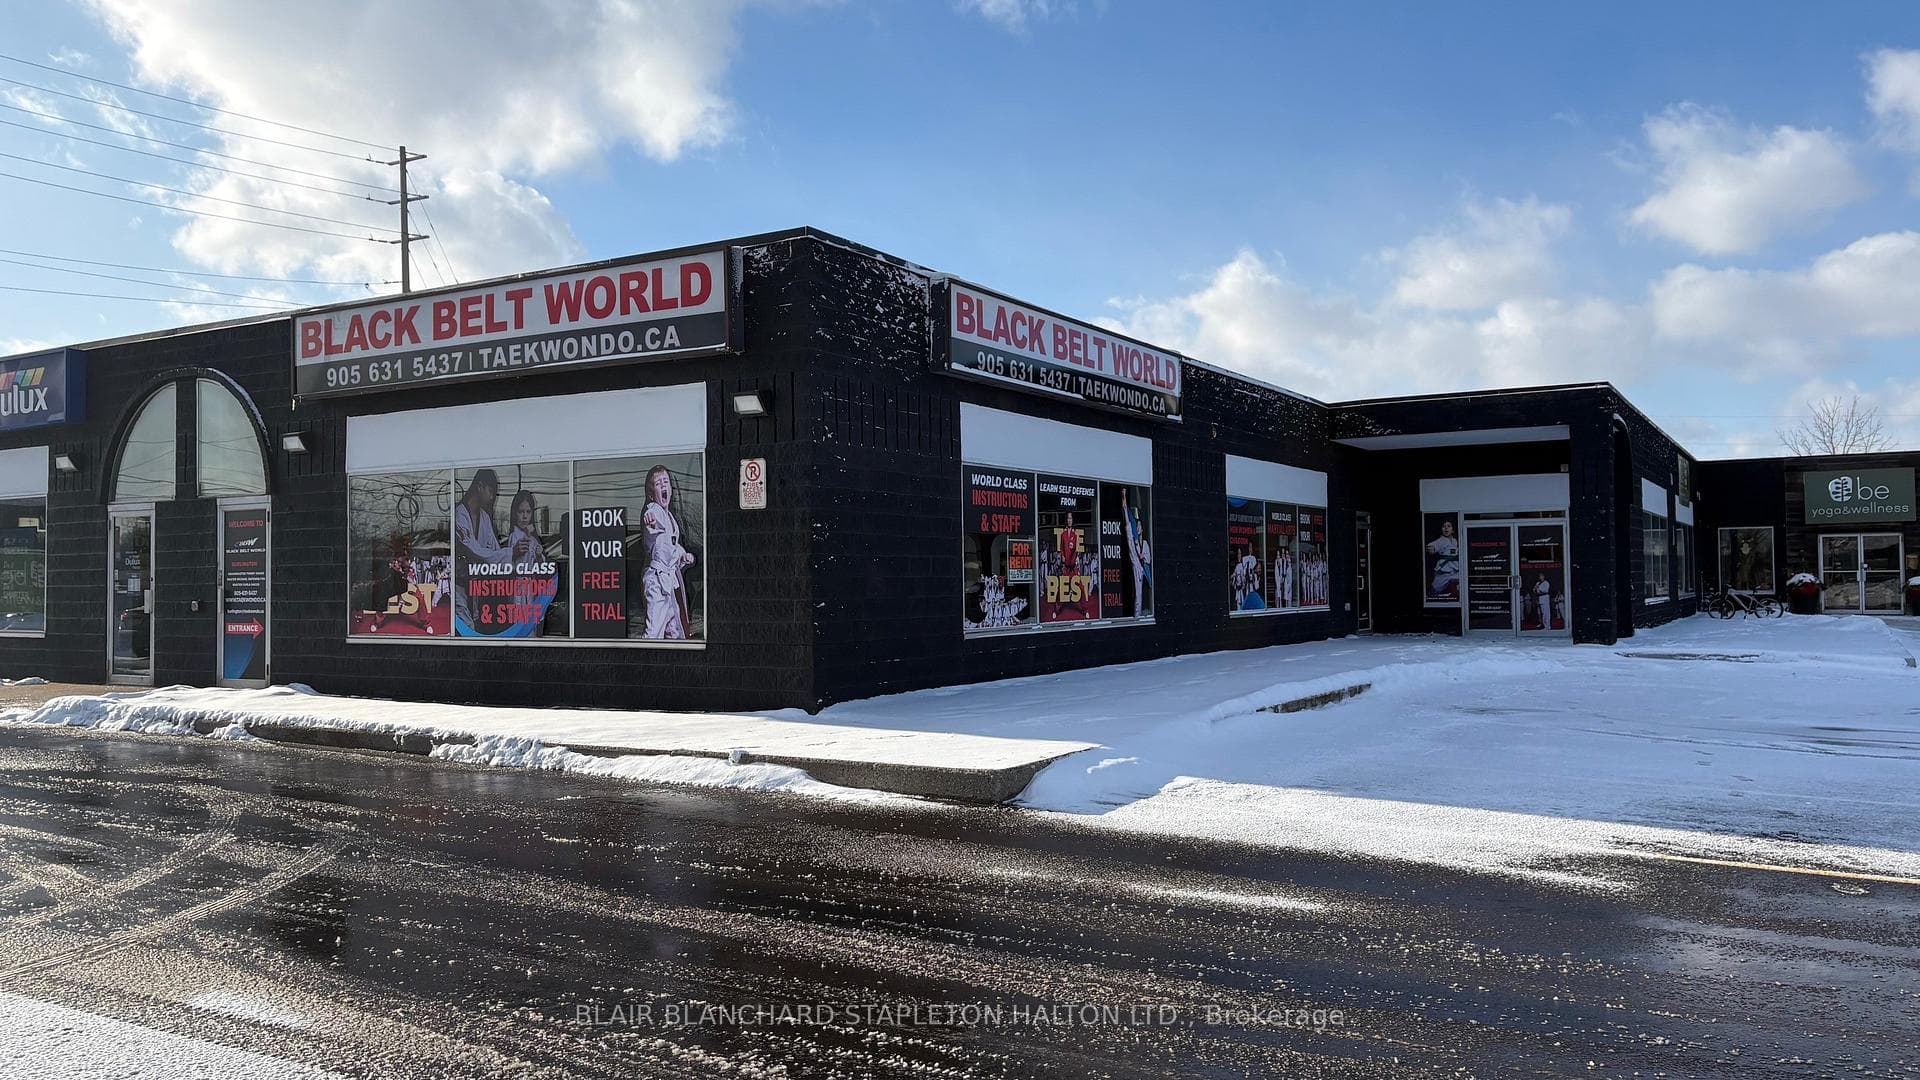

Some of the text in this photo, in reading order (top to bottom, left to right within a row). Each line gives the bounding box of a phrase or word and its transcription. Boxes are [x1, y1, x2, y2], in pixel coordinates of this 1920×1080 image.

[301, 261, 712, 359] BLACK BELT WORLD
[956, 292, 1177, 391] BLACK BELT WORLD
[326, 364, 361, 387] 905
[368, 361, 403, 382] 631
[412, 352, 463, 378] 5437
[479, 325, 682, 369] TAEKWONDO.CA
[977, 351, 1004, 375] 905
[1009, 360, 1033, 382] 631
[1040, 367, 1071, 391] 5437
[1078, 377, 1166, 414] TAEKWONDO.CA
[0, 385, 48, 416] ulux
[971, 473, 1028, 490] WORLD CLASS
[1039, 483, 1095, 497] LEARN SELF DEFENSE
[1857, 476, 1890, 500] be
[972, 489, 1028, 509] INSTRUCTORS
[1060, 497, 1077, 506] FROM
[582, 508, 624, 528] BOOK
[981, 513, 1021, 533] & STAFF
[1102, 520, 1121, 536] BOOK
[581, 540, 623, 558] YOUR
[1012, 543, 1030, 555] FOR
[1053, 527, 1085, 553] TE
[1102, 545, 1121, 559] YOUR
[468, 562, 556, 576] WORLD CLASS
[1009, 556, 1033, 569] RENT
[582, 571, 620, 590] FREE
[1103, 569, 1120, 583] FREE
[469, 578, 557, 597] INSTRUCTORS
[1046, 575, 1091, 603] BEST
[1103, 593, 1123, 607] TRIAL
[480, 603, 543, 624] & STAFF
[582, 602, 626, 621] TRIAL
[228, 624, 259, 632] ENTRANCE
